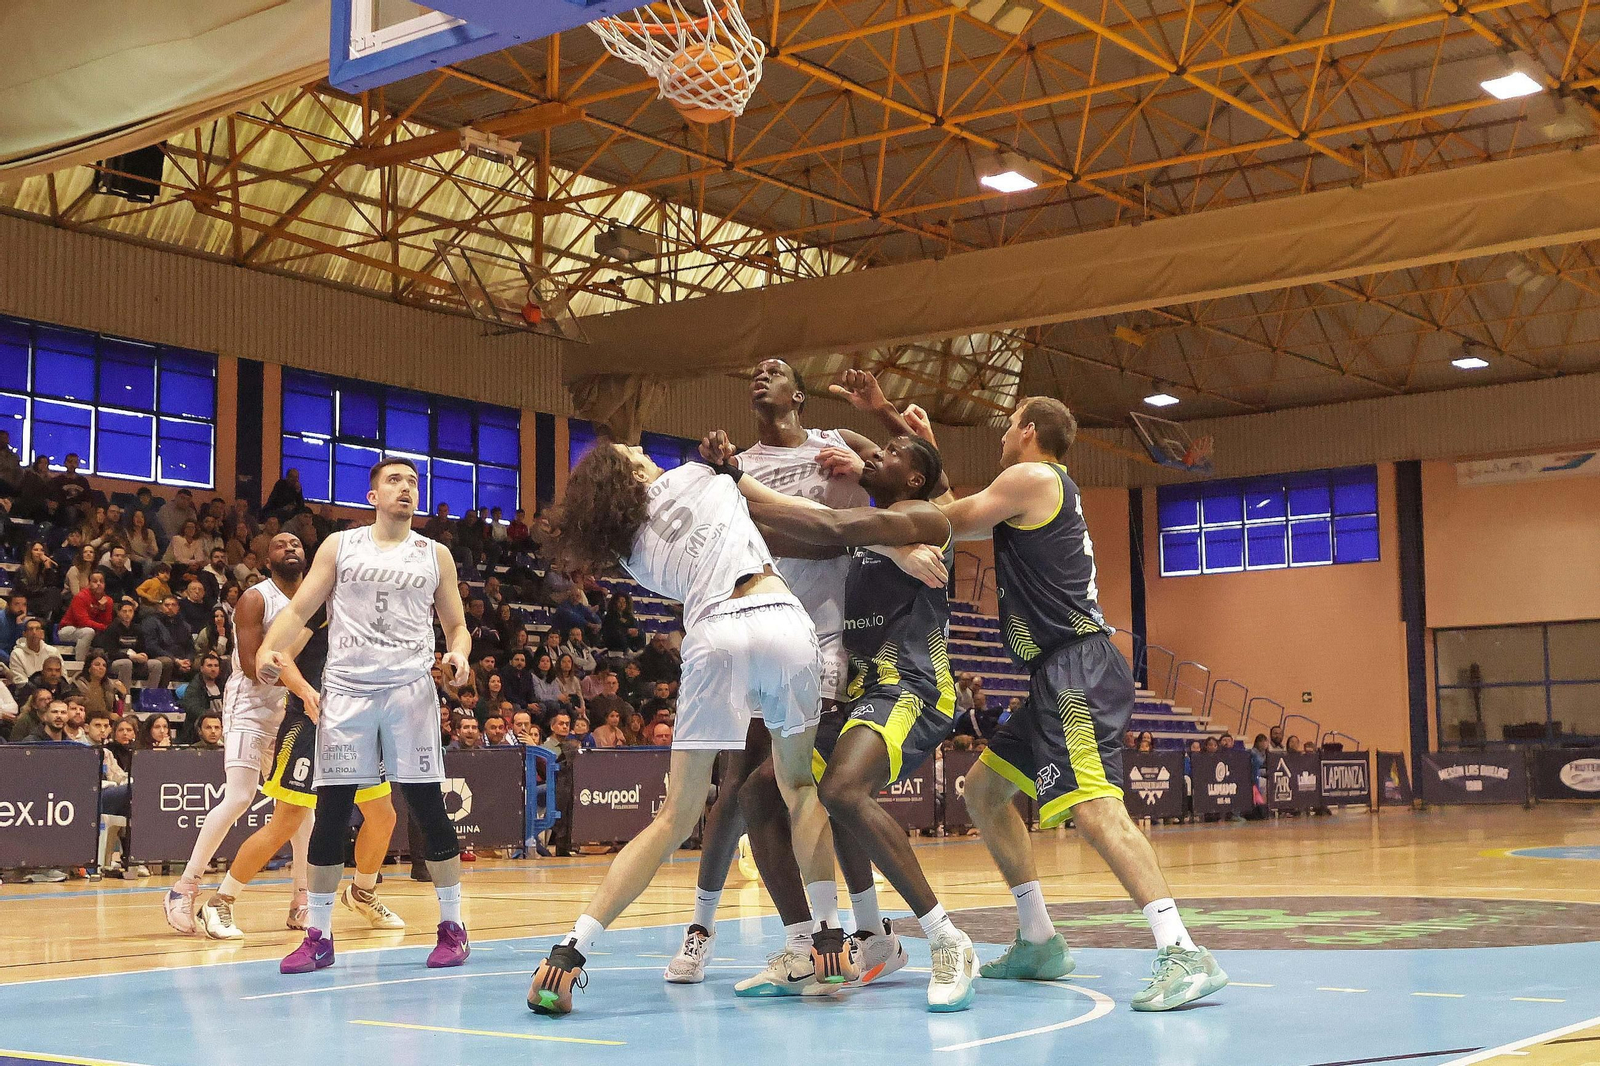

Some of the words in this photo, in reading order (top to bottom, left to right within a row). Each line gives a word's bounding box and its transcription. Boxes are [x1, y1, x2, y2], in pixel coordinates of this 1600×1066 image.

[650, 499, 693, 543] 6
[340, 563, 427, 590] clavijo
[375, 591, 389, 613] 5
[843, 613, 884, 630] mex.io
[292, 757, 311, 782] 6
[419, 755, 431, 773] 5
[592, 784, 640, 809] surpool
[0, 793, 75, 827] ex.io
[453, 825, 481, 834] UINA
